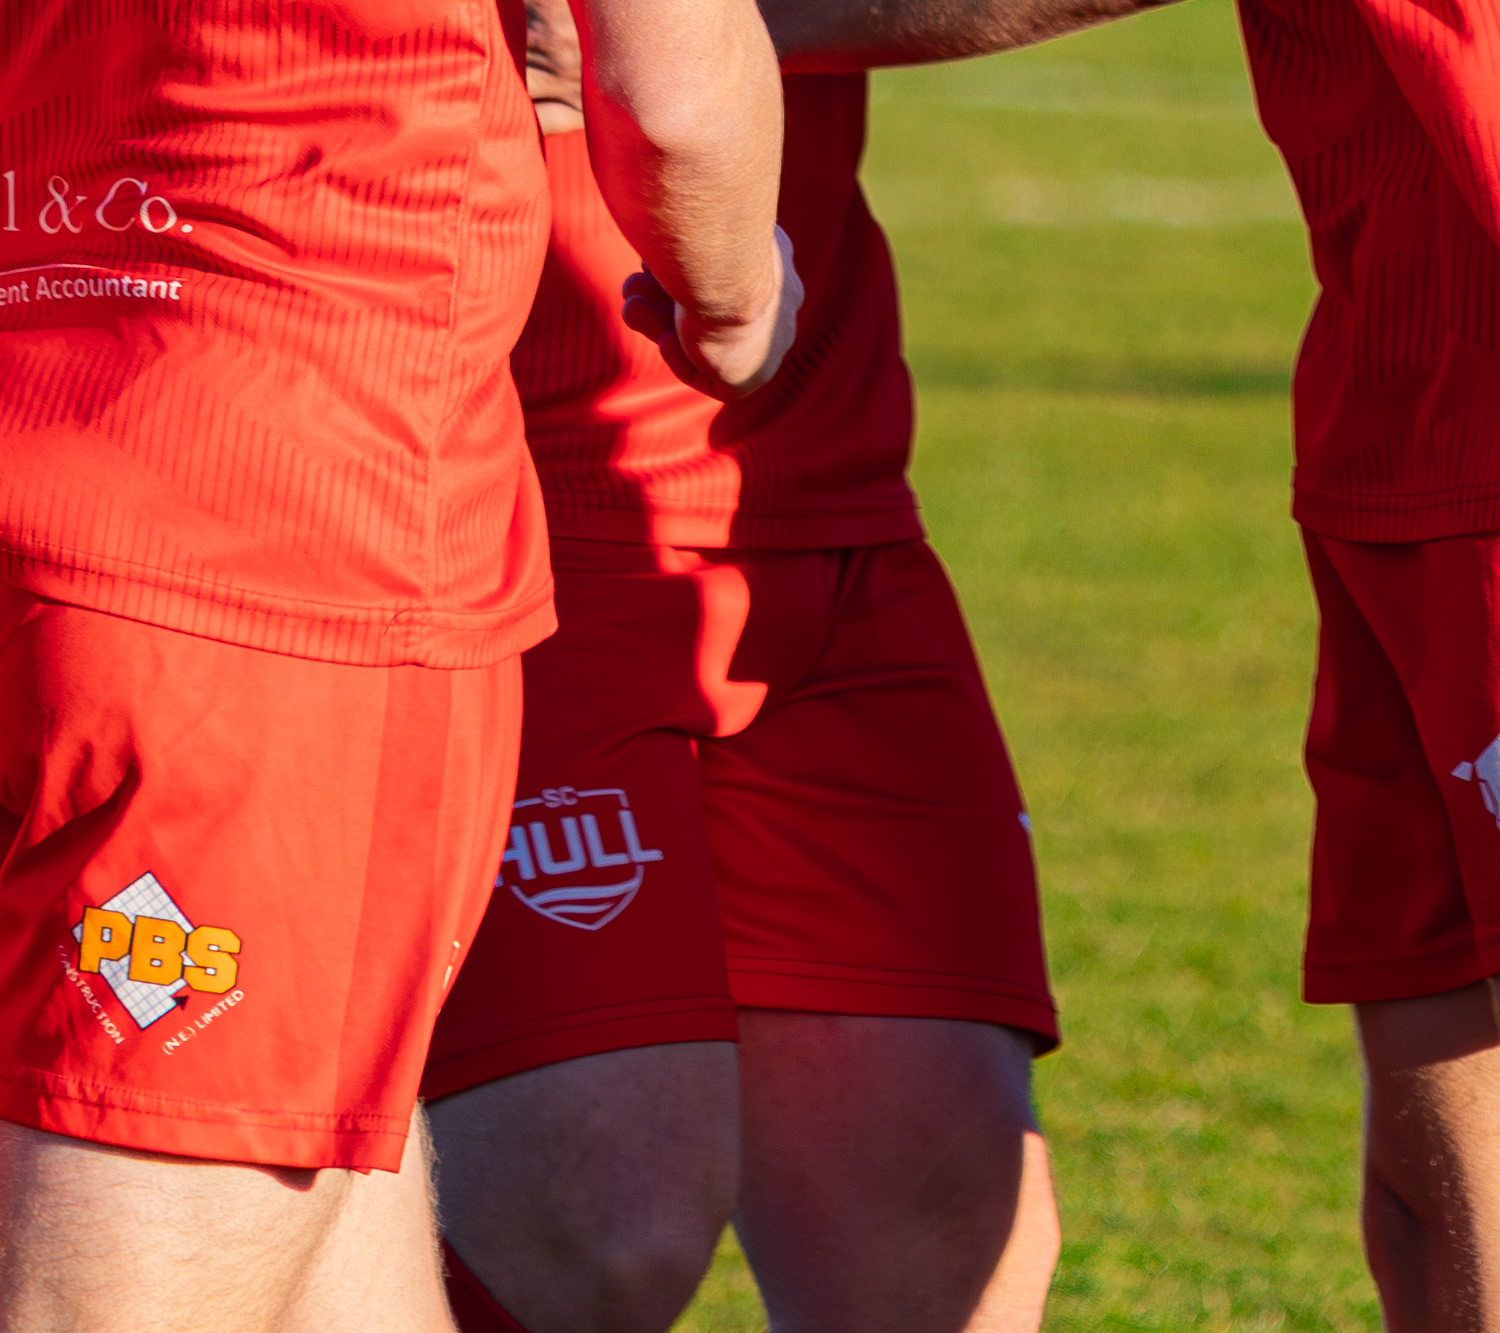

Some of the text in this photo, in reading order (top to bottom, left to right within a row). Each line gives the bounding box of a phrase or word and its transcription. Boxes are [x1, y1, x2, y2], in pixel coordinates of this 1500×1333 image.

[38, 175, 87, 234] &
[95, 177, 193, 233] Co.
[35, 276, 183, 301] Accountant
[541, 786, 578, 808] SC
[78, 904, 242, 995] PBS
[194, 989, 245, 1029] LIMITED
